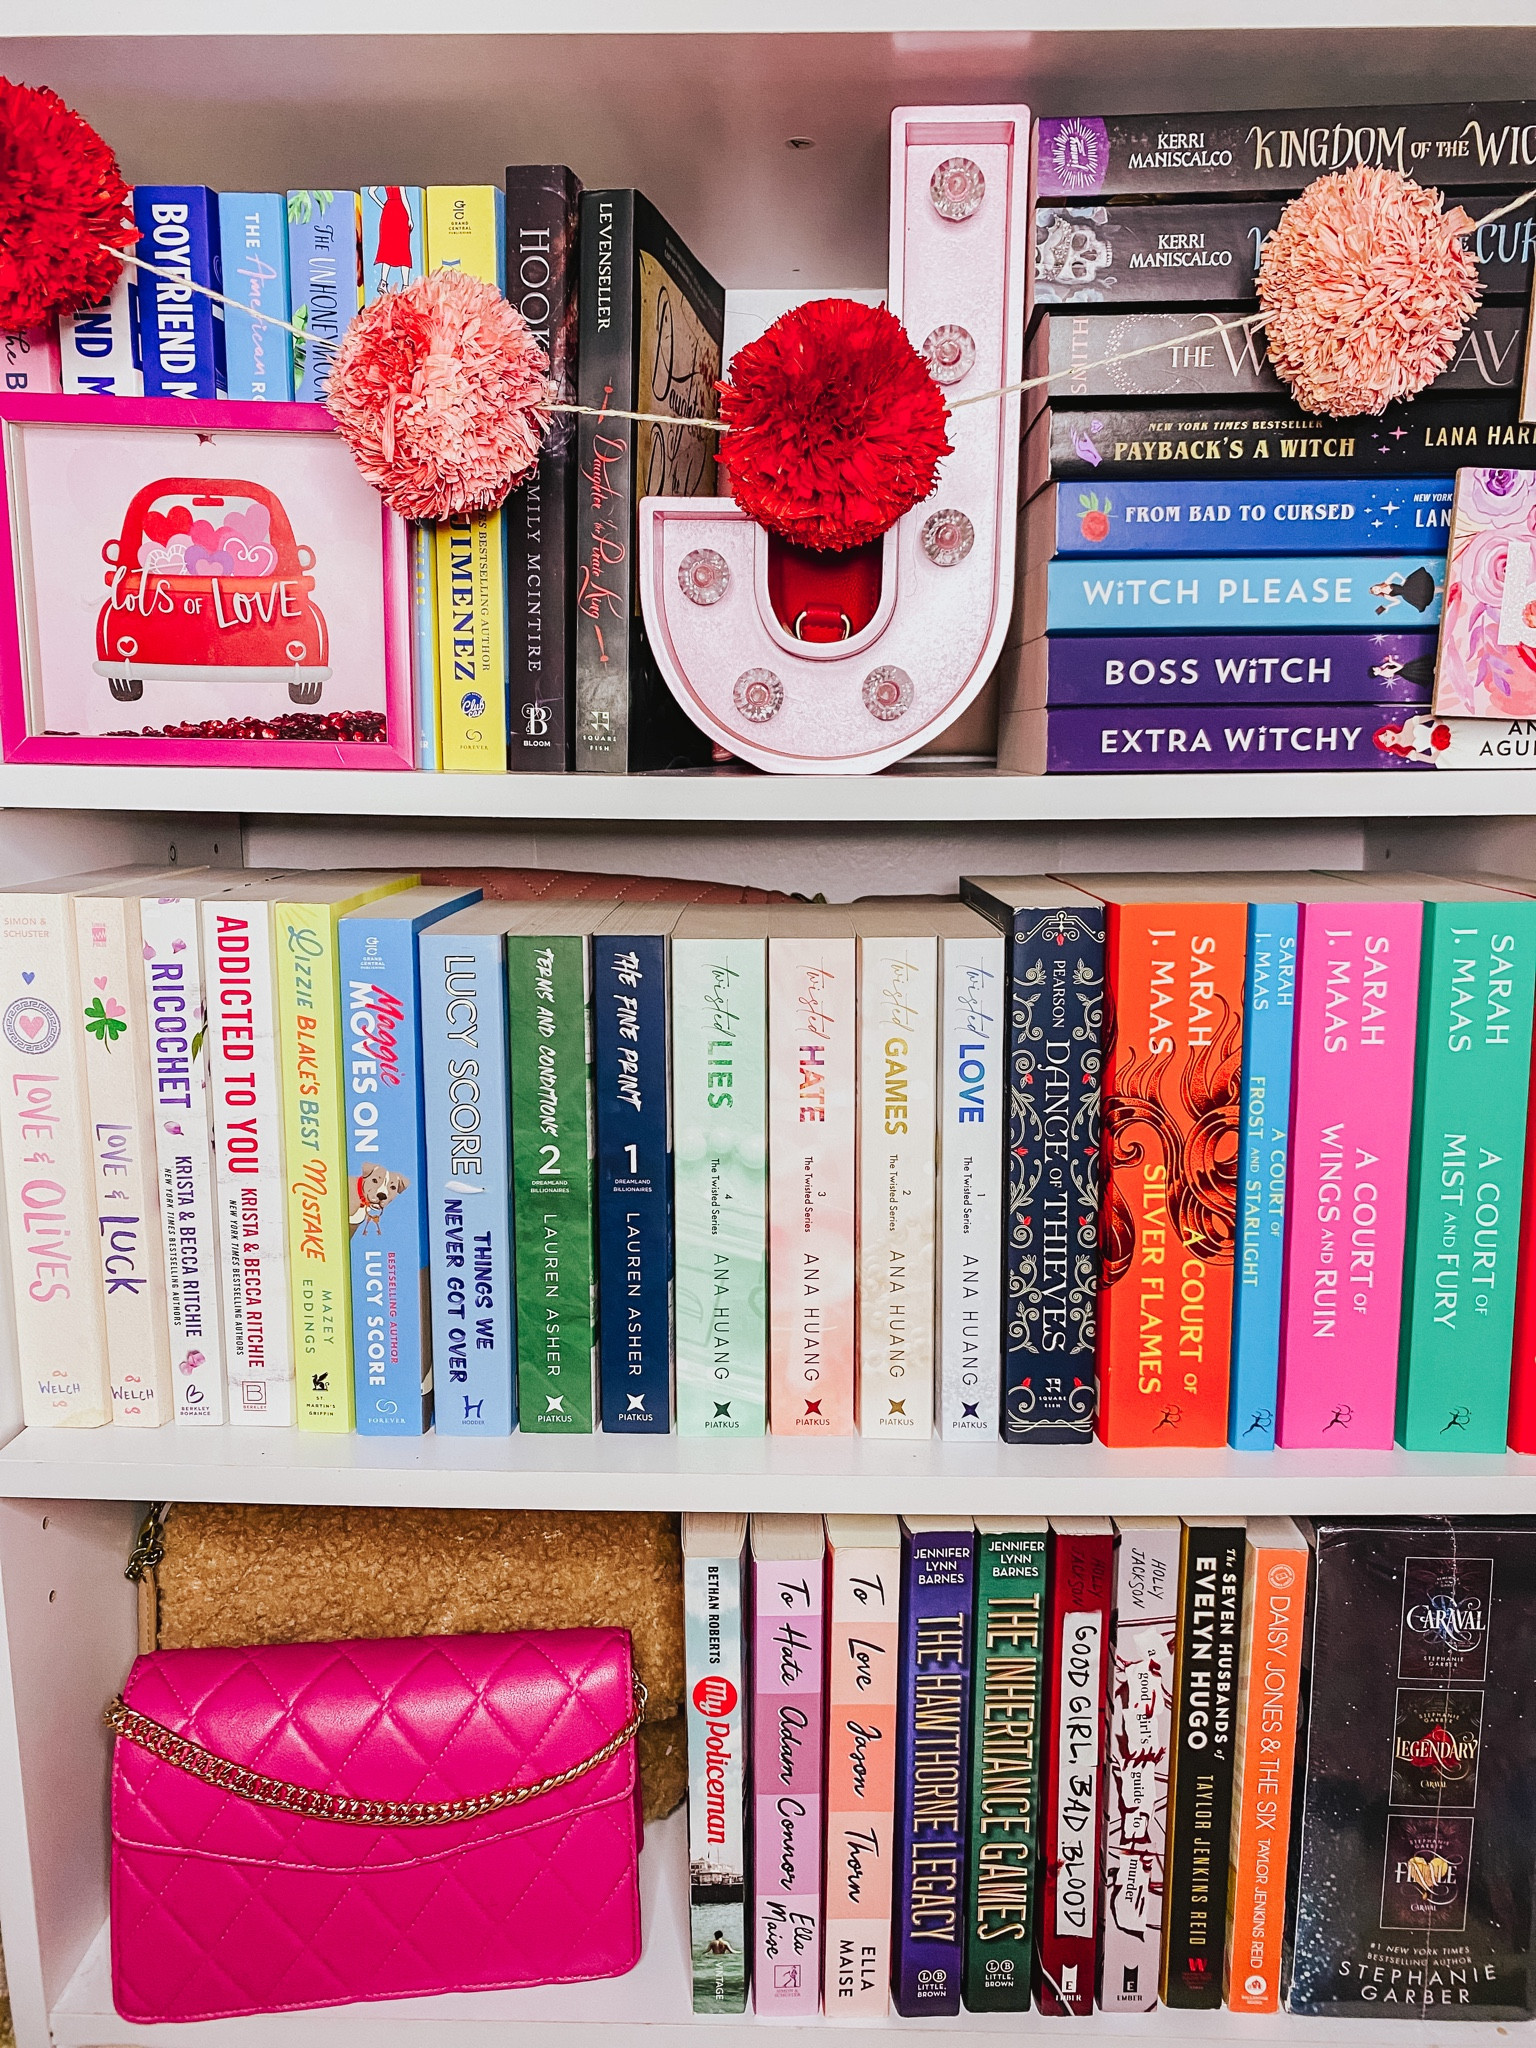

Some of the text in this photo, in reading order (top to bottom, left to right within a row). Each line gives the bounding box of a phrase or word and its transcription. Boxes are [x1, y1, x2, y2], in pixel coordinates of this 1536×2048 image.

[1128, 150, 1233, 168] MANISCALCO
[1157, 133, 1205, 150] KERRI
[1245, 122, 1414, 178] KINGDOM
[1411, 141, 1431, 159] OF
[1436, 140, 1469, 157] THE
[245, 213, 260, 248] THE
[1158, 234, 1205, 250] KERRI
[598, 202, 613, 333] LEVENSELLER
[1129, 251, 1233, 268] MANISCALCO
[237, 253, 278, 376] American
[1114, 437, 1356, 461] PAYBACK'S A WITCH
[1148, 420, 1323, 432] NEW YORK TIMES BESTSELLER
[1425, 426, 1478, 447] LANA
[1125, 503, 1355, 524] FROM BAD TO CURSED
[1413, 493, 1453, 502] NEW YORK
[450, 514, 476, 681] JIMENEZ
[479, 532, 489, 615] BESTSELLING
[1218, 578, 1353, 603] PLEASE
[527, 553, 541, 672] MCINTIRE
[480, 621, 491, 671] AUTHOR
[1105, 659, 1199, 686] BOSS
[1101, 728, 1212, 754] EXTRA
[3, 930, 50, 938] SCHUSTER
[4, 917, 47, 926] SIMON &
[1188, 936, 1216, 1046] SARAH
[1277, 937, 1295, 1006] SARAH
[1360, 936, 1389, 1045] SARAH
[1485, 935, 1514, 1044] SARAH
[151, 963, 192, 1109] RICOCHET
[216, 915, 259, 1174] ADDICTED TO YOU
[444, 955, 482, 1175] LUCY SCORE
[538, 1144, 561, 1174] 2
[624, 1144, 637, 1174] 1
[1312, 1122, 1345, 1338] WINGS AND RUIN
[1433, 1133, 1467, 1330] MIST AND FURY
[444, 1199, 468, 1382] NEVER GOT OVER
[473, 1231, 494, 1350] THINGS WE
[544, 1214, 560, 1376] LAUREN ASHER
[626, 1213, 642, 1375] LAUREN ASHER
[1138, 1164, 1167, 1394] SILVER FLAMES
[302, 1280, 316, 1354] EDDINGS
[364, 1251, 386, 1386] LUCY SCORE
[387, 1252, 399, 1364] BESTSELLING AUTHOR
[714, 1253, 729, 1379] ANA HUANG
[804, 1254, 820, 1381] ANA HUANG
[889, 1250, 905, 1378] ANA HUANG
[962, 1254, 979, 1386] ANA HUANG
[538, 1415, 572, 1423] PIATKUS
[618, 1413, 653, 1421] PIATKUS
[704, 1420, 740, 1429] PIATKUS
[795, 1418, 830, 1426] PIATKUS
[879, 1418, 914, 1426] PIATKUS
[952, 1421, 988, 1429] PIATKUS
[913, 1548, 970, 1559] JENNIFER
[926, 1561, 957, 1572] LYNN
[988, 1541, 1045, 1552] JENNIFER
[992, 1567, 1039, 1577] BARNES
[1000, 1554, 1032, 1564] LYNN
[918, 1574, 964, 1584] BARNES
[1129, 1548, 1146, 1609] JACKSON
[1150, 1558, 1166, 1600] HOLLY
[707, 1566, 721, 1664] BETHAN ROBERTS
[1266, 1595, 1290, 1657] DAISY
[1187, 1557, 1217, 1750] EVELYN HUGO
[1261, 1663, 1286, 1733] JONES
[844, 1574, 886, 1904] To Love Jason Thorn
[977, 1592, 1040, 1940] THE INHERITANCE GAMES
[1260, 1738, 1281, 1754] &
[910, 1612, 964, 1942] THE HAWTHORNE LEGACY
[1061, 1625, 1097, 1928] GOOD GIRL, BAD BLOOD
[1125, 1649, 1156, 1902] a good girl's guide to murder
[1257, 1758, 1280, 1795] THE
[1255, 1800, 1277, 1831] SIX
[1189, 1775, 1214, 1945] TAYLOR JENKINS REID
[1249, 1838, 1271, 1969] TAYLOR JENKINS REID
[715, 1961, 724, 2000] VINTAGE
[838, 1940, 855, 1998] MAISE
[861, 1946, 876, 1991] ELLA
[1338, 1960, 1497, 1986] STEPHANIE
[1361, 1985, 1471, 2005] GARBER
